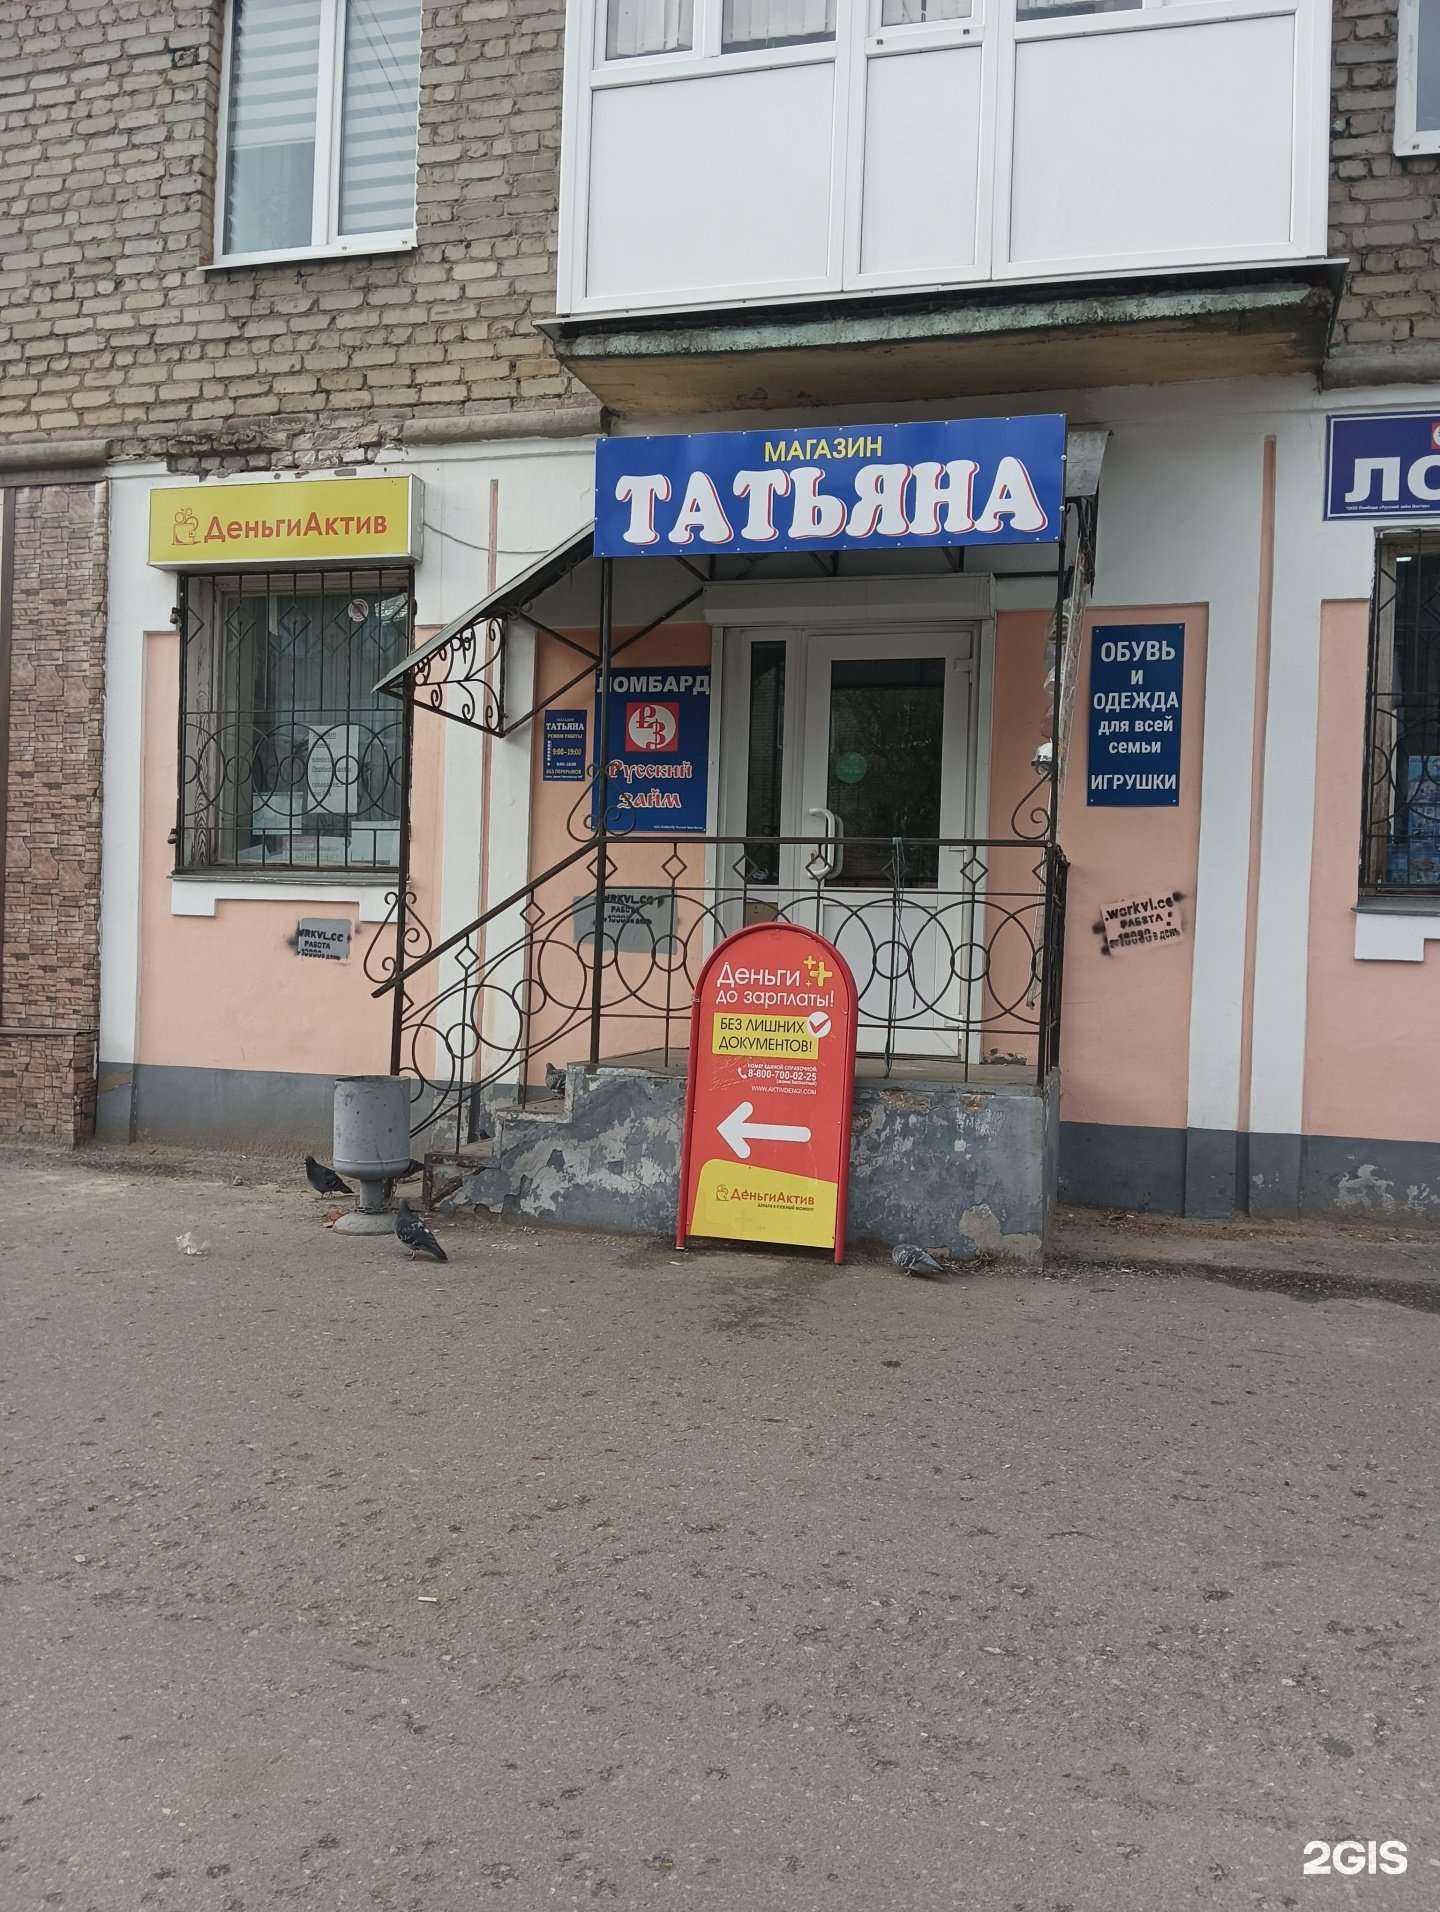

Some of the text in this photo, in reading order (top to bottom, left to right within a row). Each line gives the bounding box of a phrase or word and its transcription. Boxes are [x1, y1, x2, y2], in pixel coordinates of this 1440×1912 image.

[764, 436, 882, 462] МАГАЗИН
[615, 456, 1049, 545] ТАТЬЯНА
[204, 511, 387, 543] ДеньгиАктив
[1100, 640, 1176, 662] ОБУВЬ
[1093, 691, 1179, 713] ОДЕЖДА
[546, 722, 584, 731] ТАТЬЯНА
[1098, 715, 1173, 736] для всей
[1109, 741, 1161, 754] семьи
[1091, 774, 1176, 790] ИГРУШКИ
[716, 961, 801, 988] Деньги
[716, 989, 835, 1009] до зарплаты!
[720, 1017, 805, 1034] БЕЗ ЛИШНИХ
[718, 1035, 812, 1052] ДОКУМЕНТОВ!
[748, 1069, 817, 1081] 8-800-700-02-25
[730, 1188, 815, 1205] ДеньгиАктив
